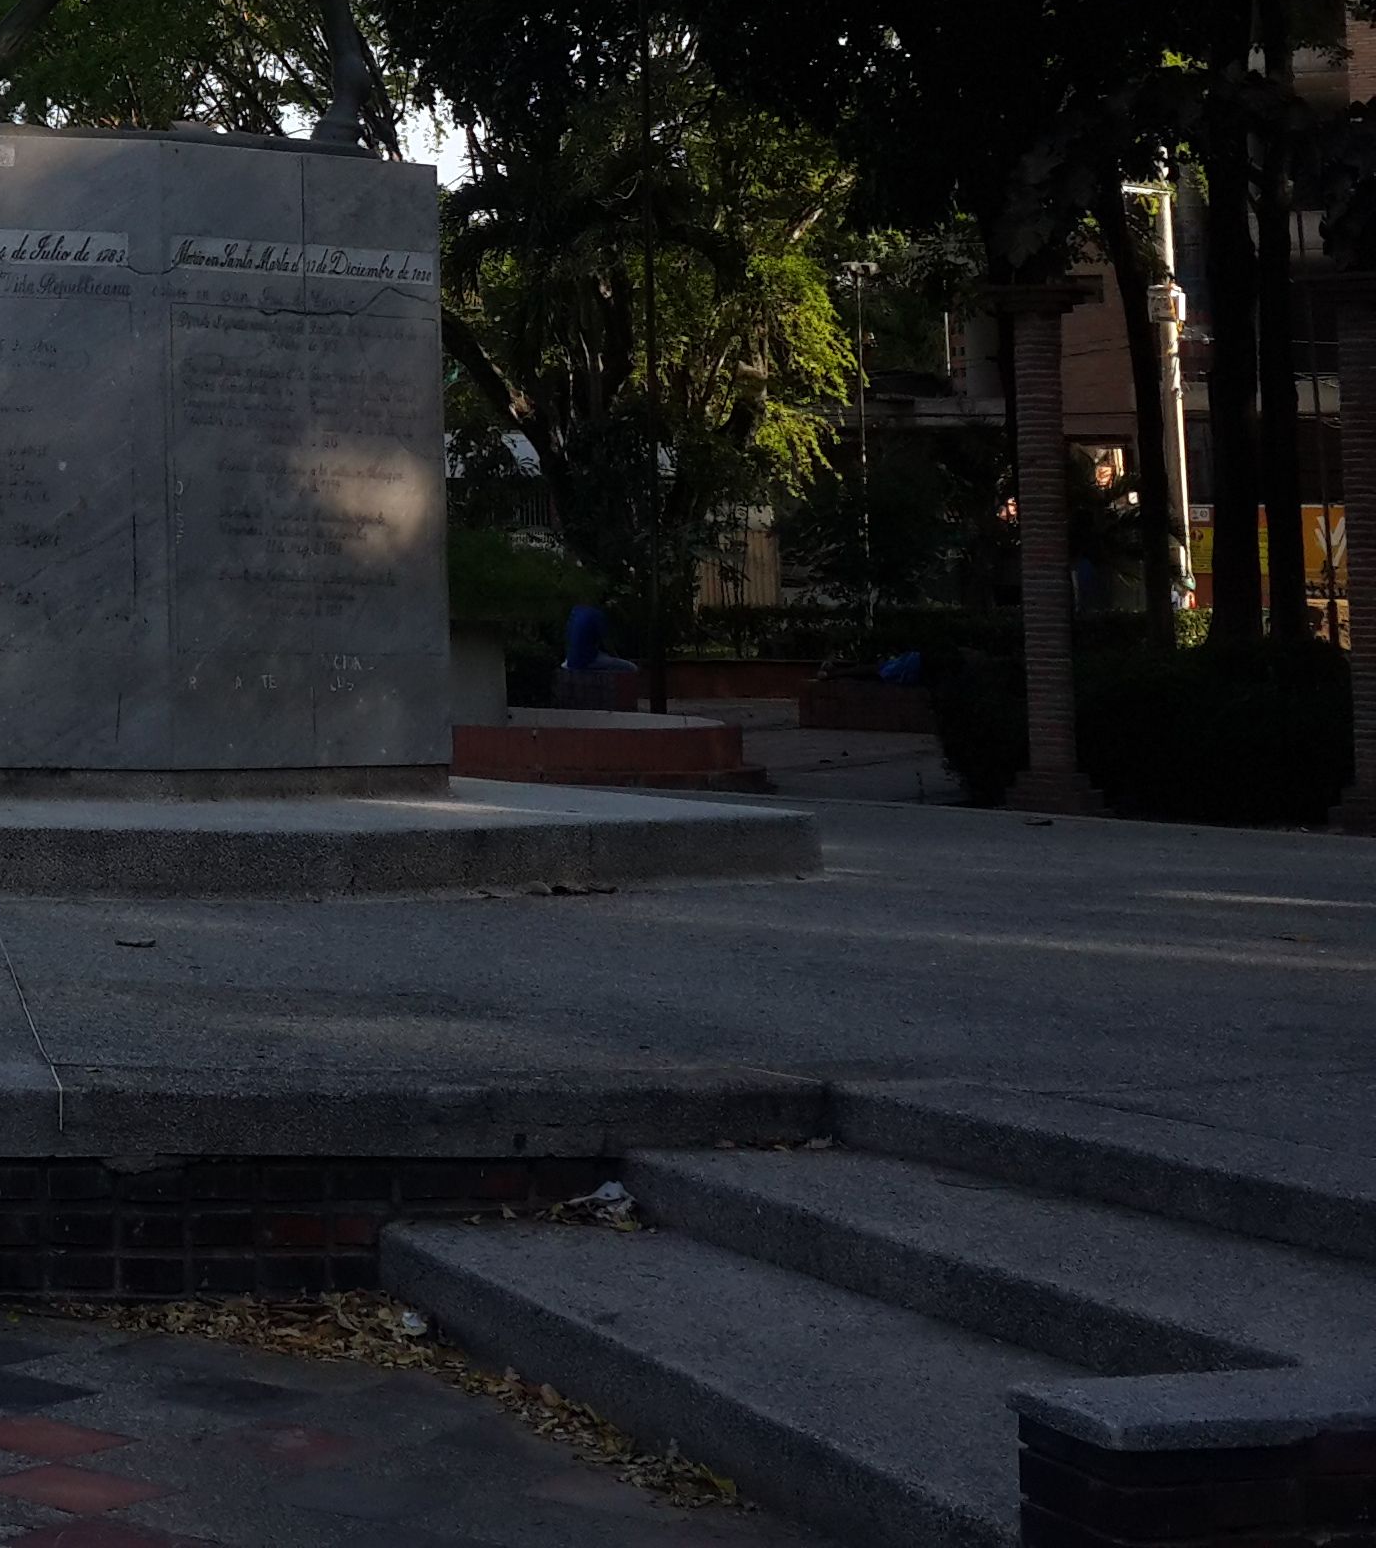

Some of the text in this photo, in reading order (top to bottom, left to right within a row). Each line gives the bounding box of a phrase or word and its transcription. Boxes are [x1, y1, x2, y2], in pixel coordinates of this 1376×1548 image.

[11, 234, 30, 261] de
[30, 234, 71, 261] Julio
[73, 236, 91, 261] de
[205, 255, 219, 267] en
[220, 243, 253, 269] Santa
[317, 249, 329, 274] de
[329, 251, 394, 279] Diciembre
[397, 254, 410, 279] de
